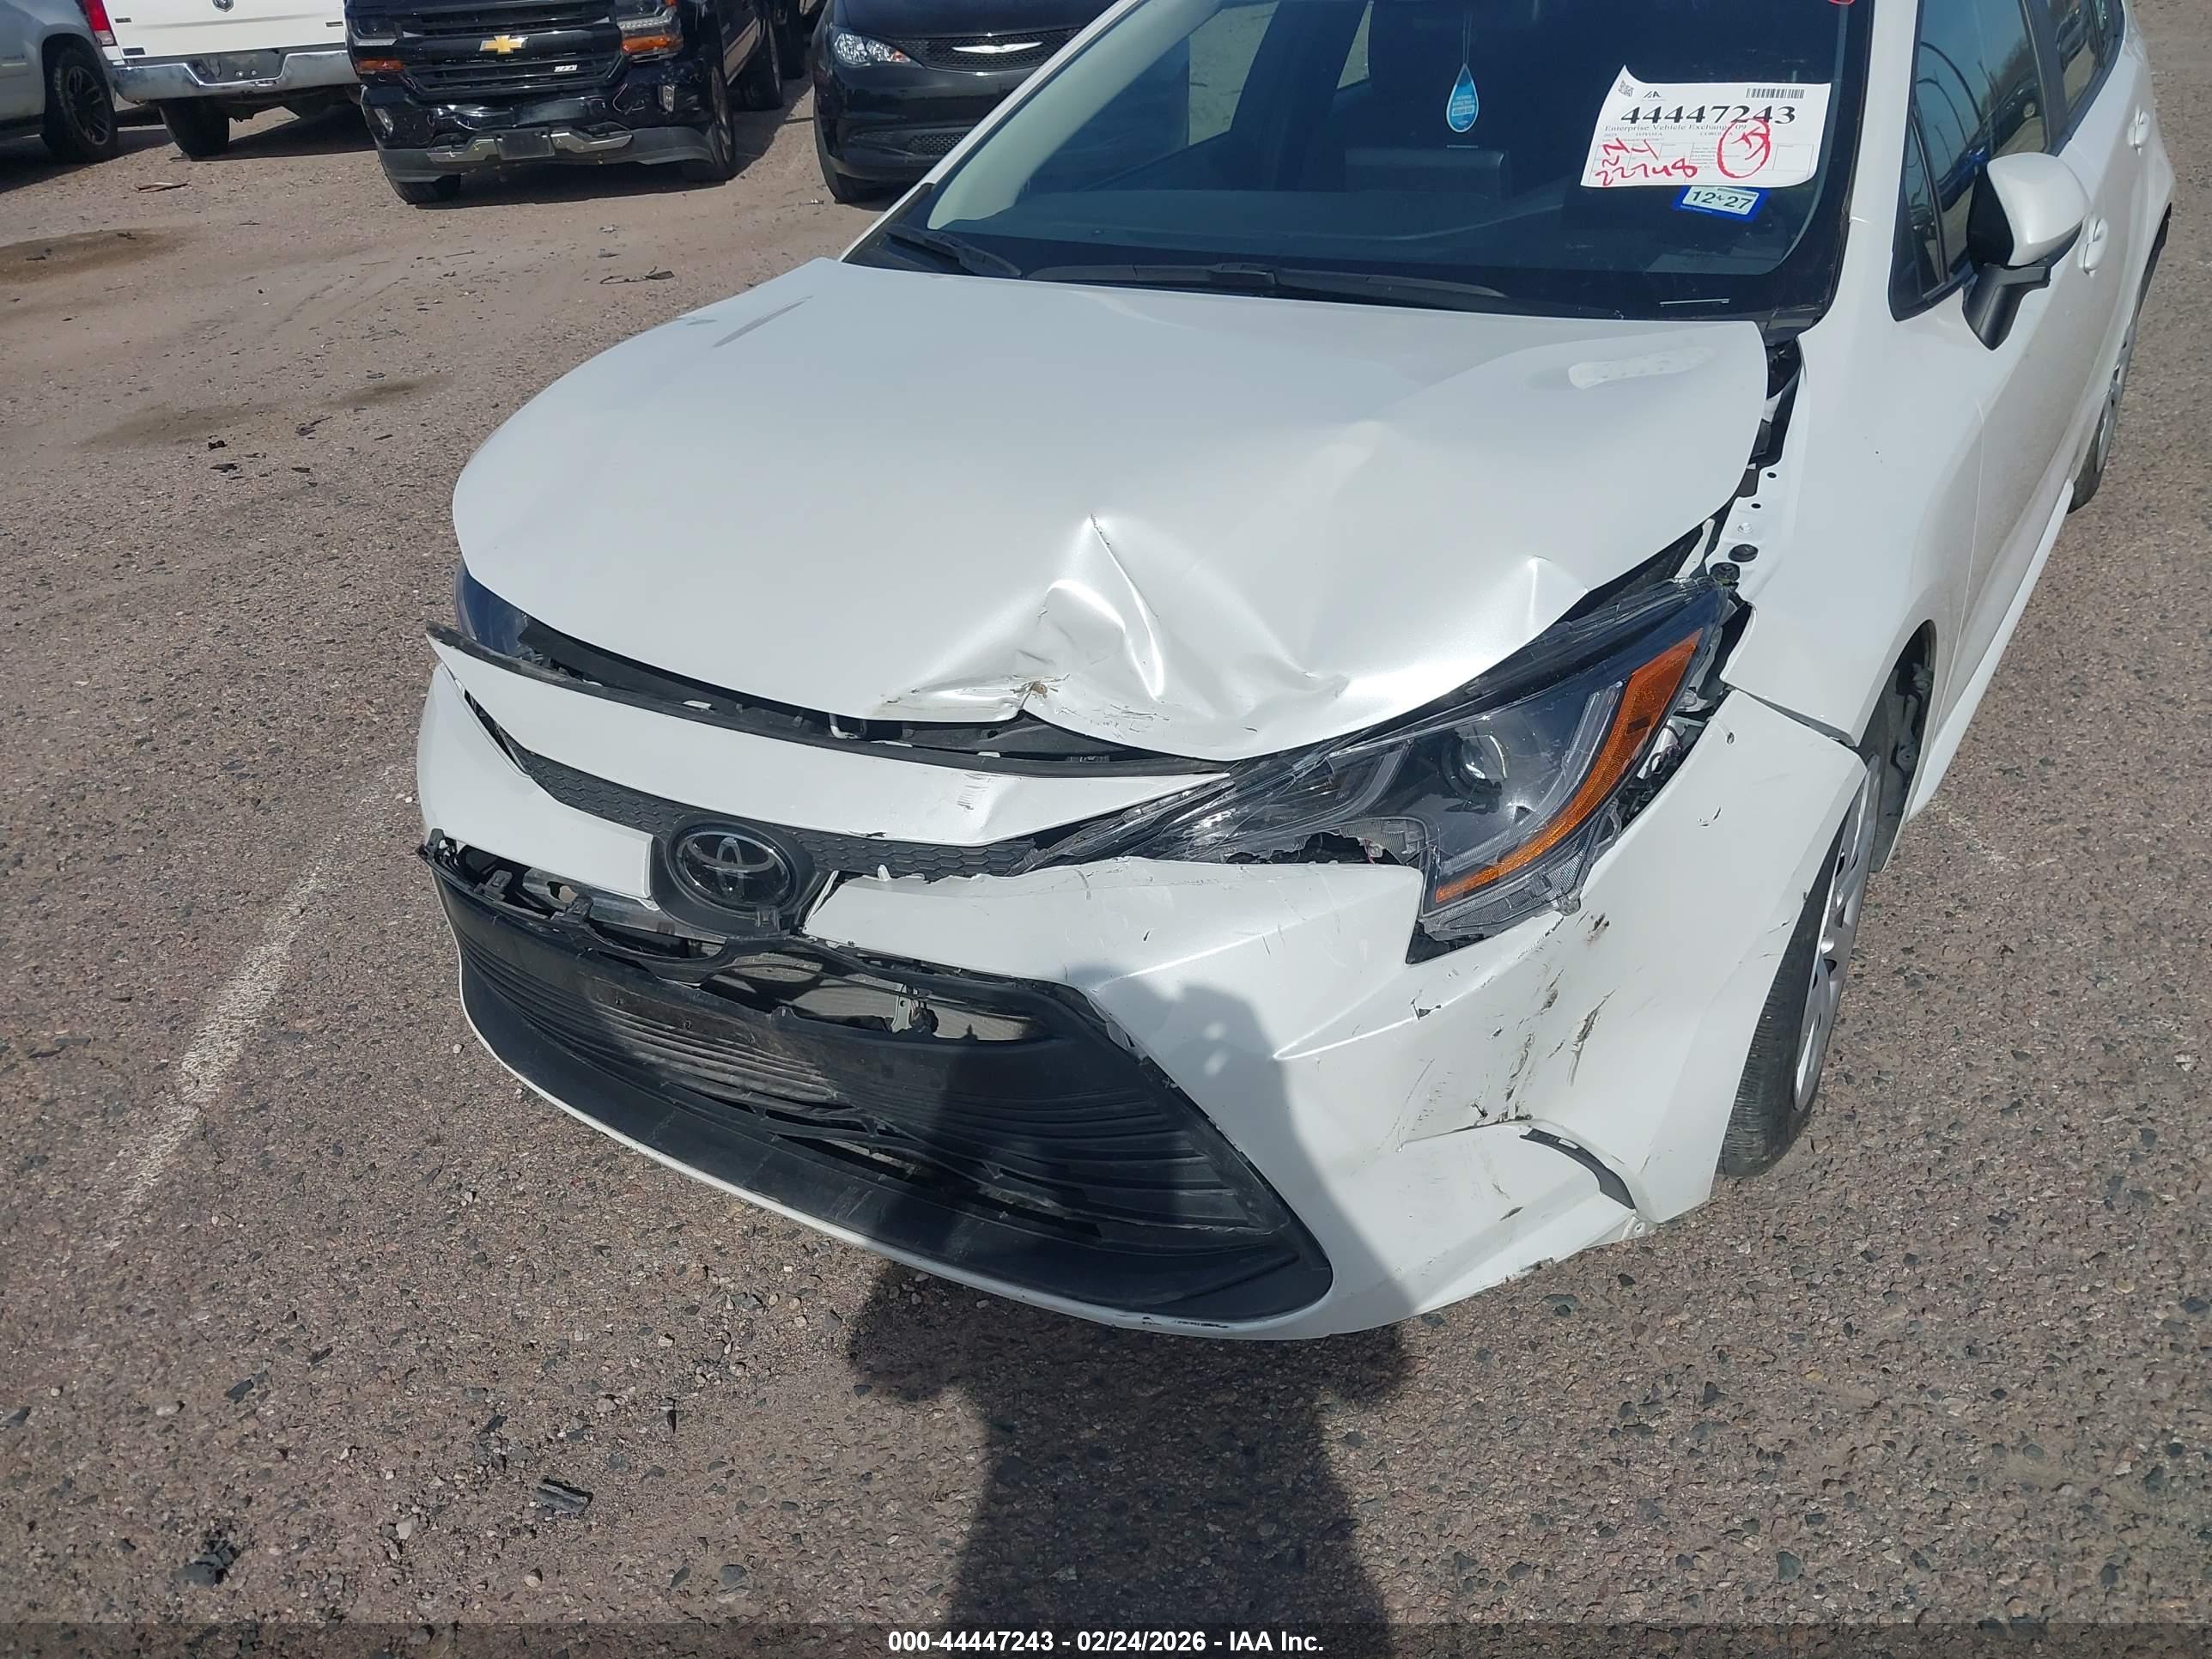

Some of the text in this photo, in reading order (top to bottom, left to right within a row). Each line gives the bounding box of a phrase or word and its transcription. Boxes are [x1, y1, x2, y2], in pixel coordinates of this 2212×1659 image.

[1620, 105, 1796, 125] 44447243
[1692, 191, 1717, 204] 12
[1723, 196, 1753, 210] 27
